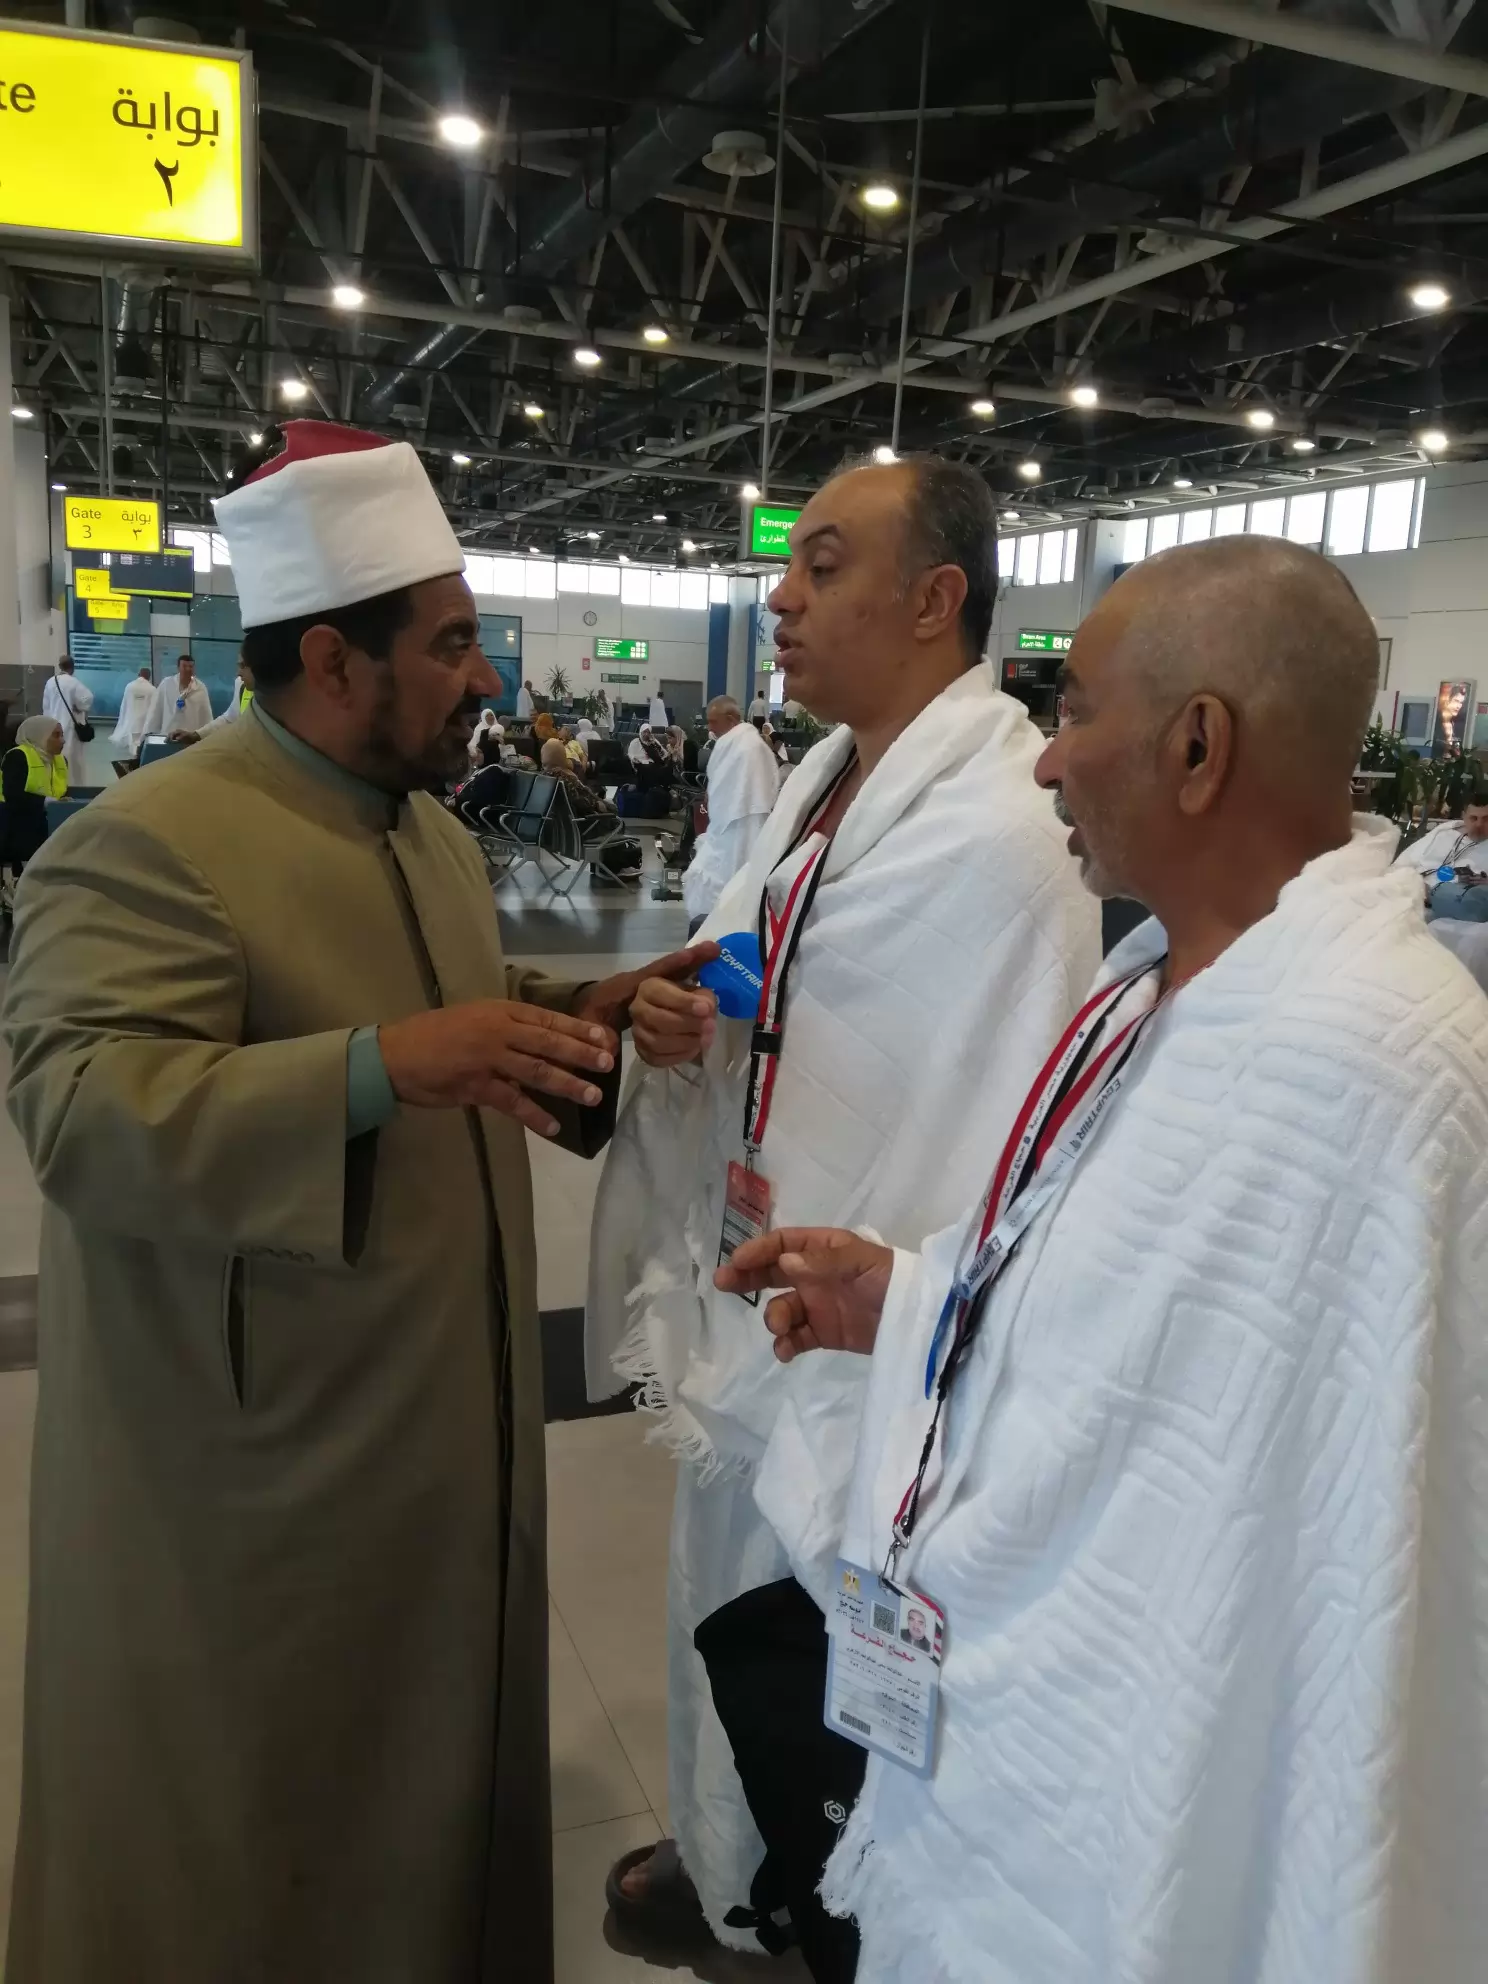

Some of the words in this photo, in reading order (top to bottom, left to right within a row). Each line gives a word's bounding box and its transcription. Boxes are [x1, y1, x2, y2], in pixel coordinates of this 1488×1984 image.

[112, 87, 219, 147] بوابة
[154, 157, 179, 207] ٢
[71, 507, 101, 519] Gate
[121, 510, 151, 525] بوابة
[760, 517, 796, 530] Emerge
[82, 525, 92, 539] 3
[132, 528, 142, 541] ٣
[85, 585, 91, 593] 4
[719, 947, 764, 990] EGYPTAIR
[1075, 1077, 1121, 1142] EGYPTAIR
